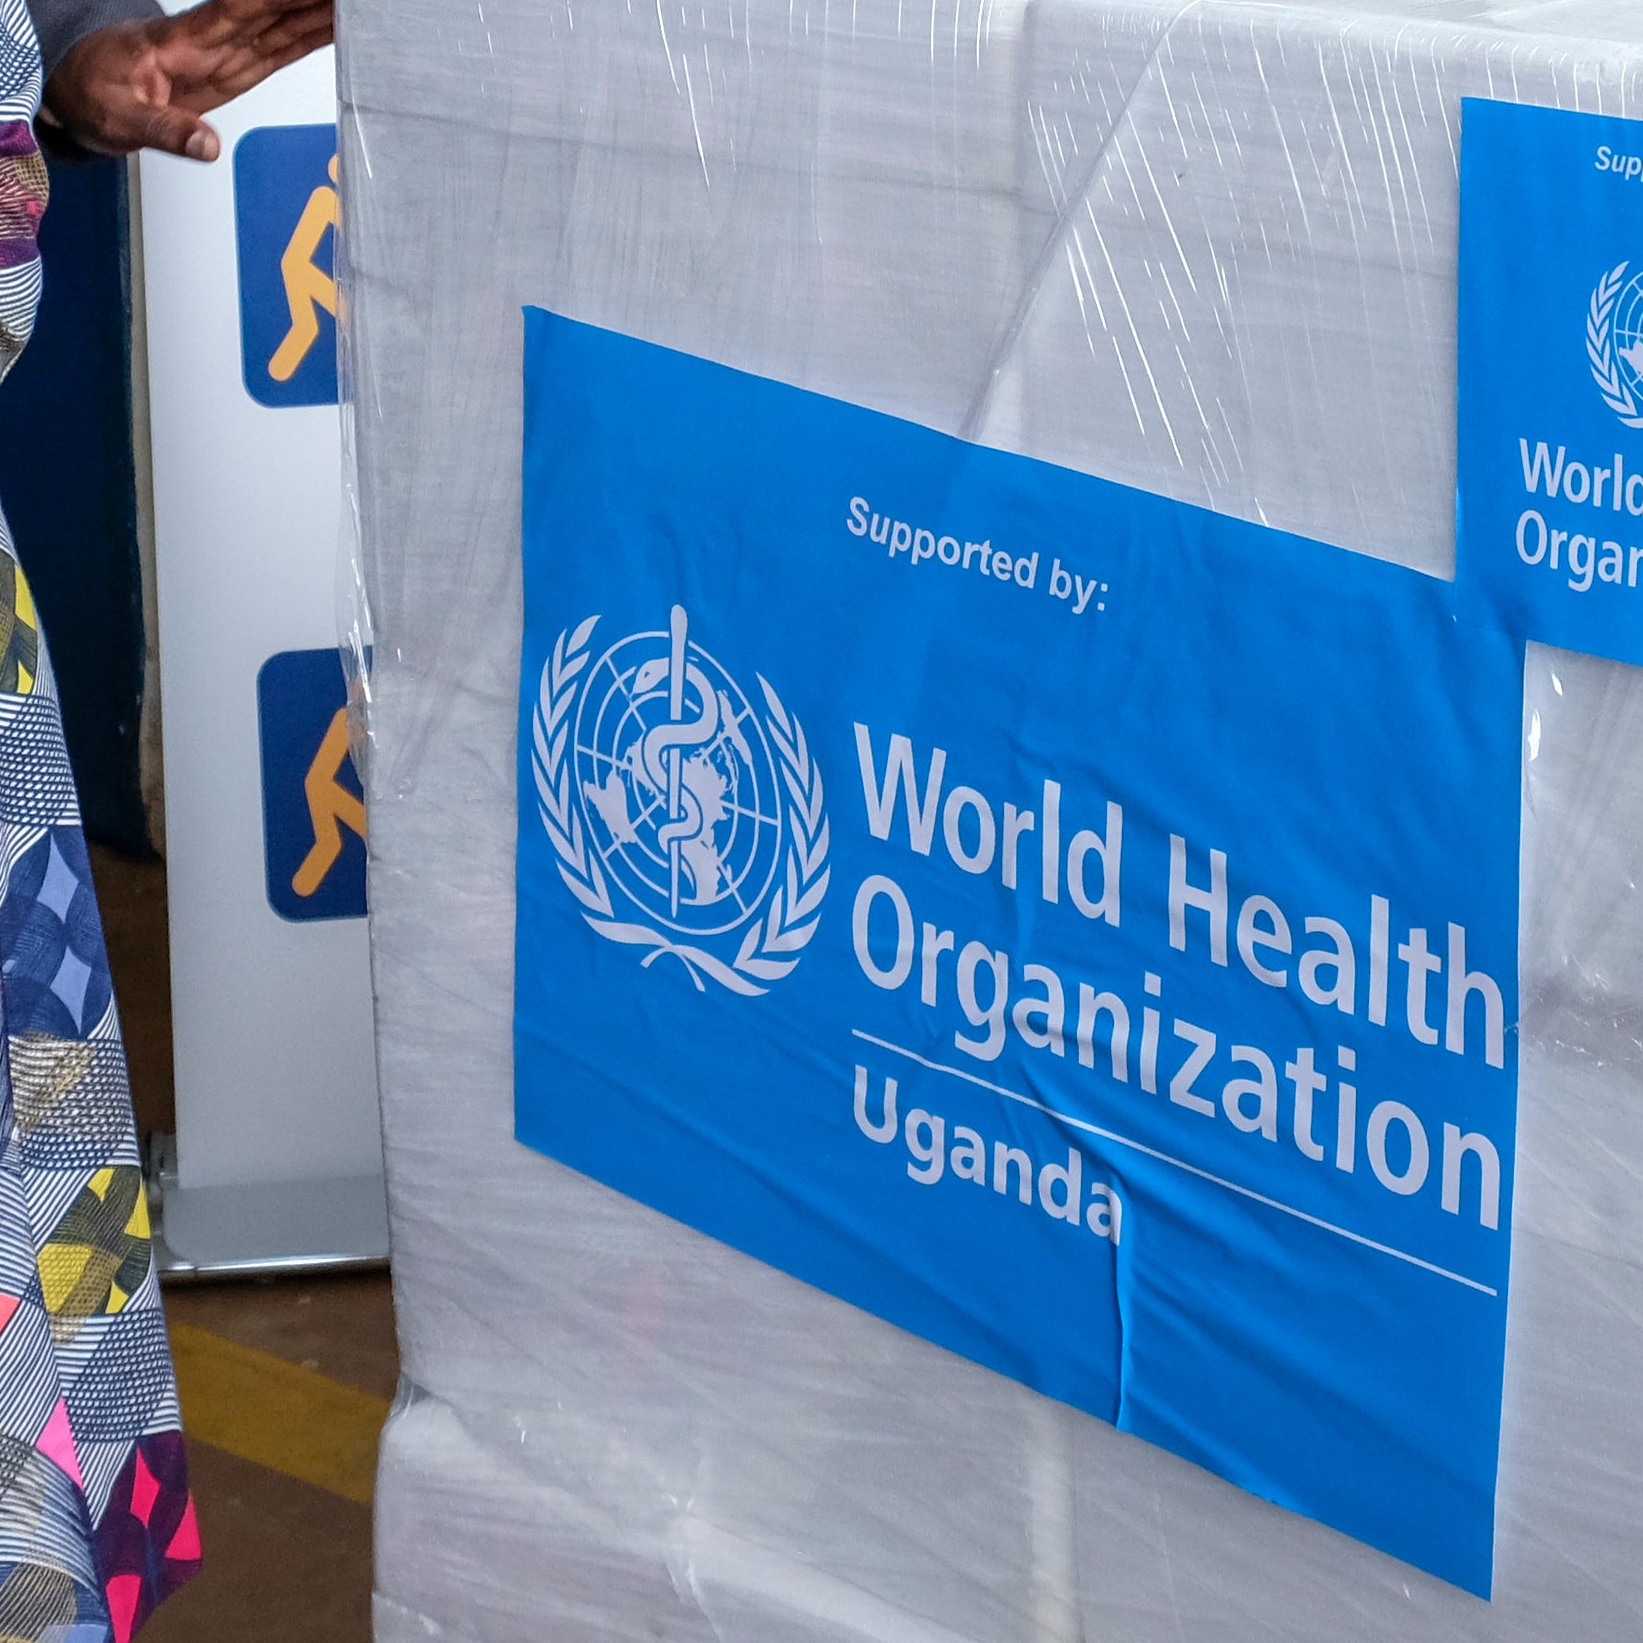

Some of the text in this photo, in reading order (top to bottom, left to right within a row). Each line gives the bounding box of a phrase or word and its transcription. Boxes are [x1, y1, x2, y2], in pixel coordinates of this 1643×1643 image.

[847, 496, 1109, 614] Supported by:
[854, 720, 1507, 1069] World Health
[852, 875, 1500, 1230] Organization
[854, 1065, 1123, 1246] Uganda
